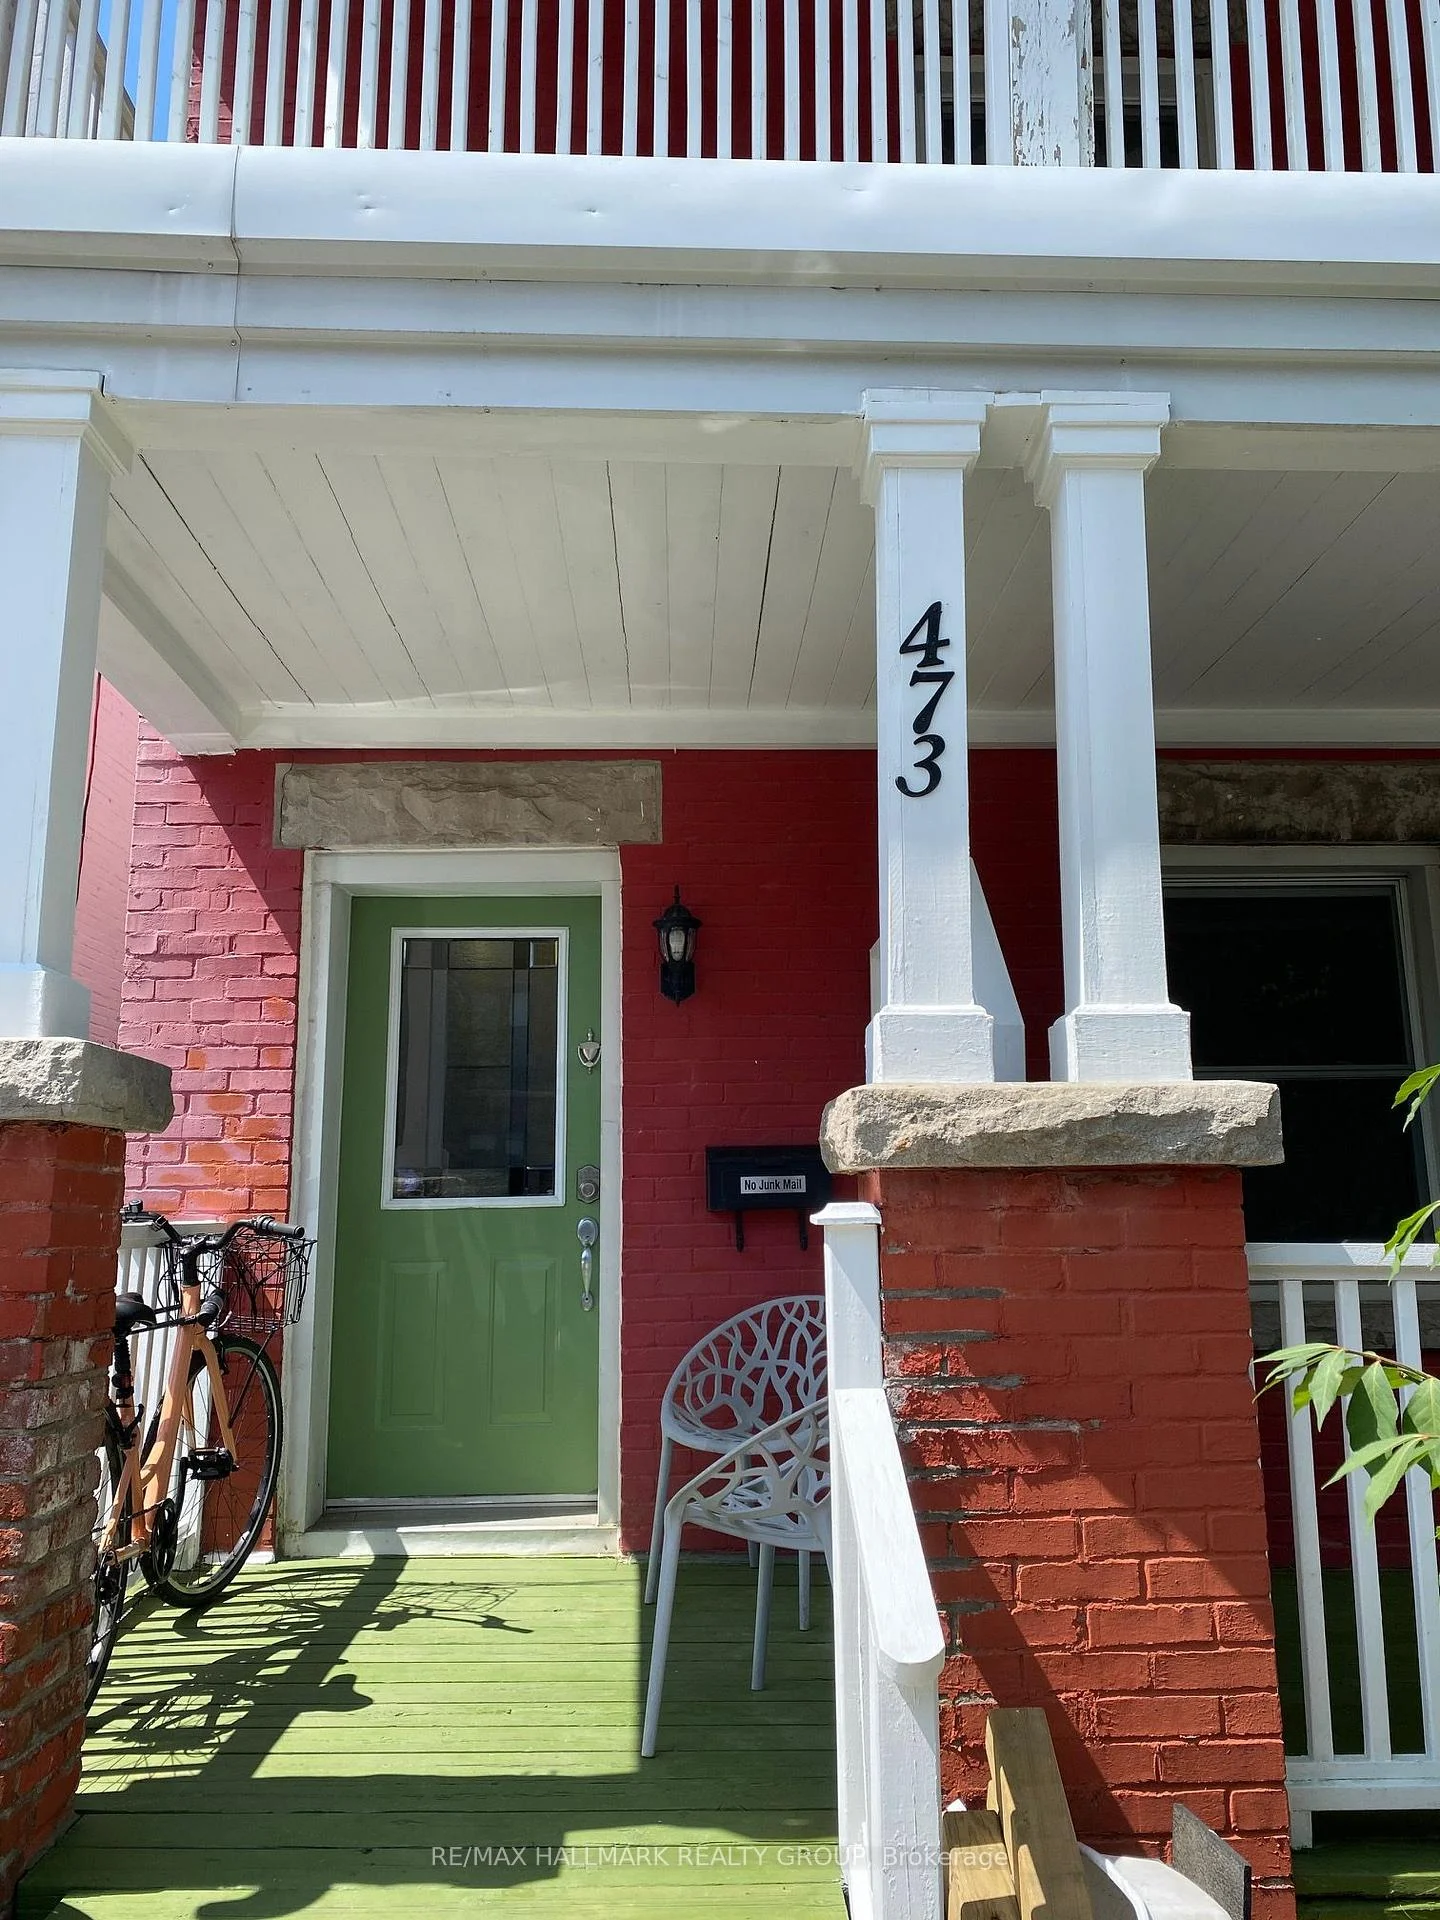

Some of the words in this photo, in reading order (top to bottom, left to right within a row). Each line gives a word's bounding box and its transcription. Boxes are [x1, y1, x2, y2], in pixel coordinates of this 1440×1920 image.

[895, 601, 955, 797] 473
[744, 1180, 756, 1190] No
[759, 1179, 780, 1190] Junk
[783, 1179, 802, 1189] Mail
